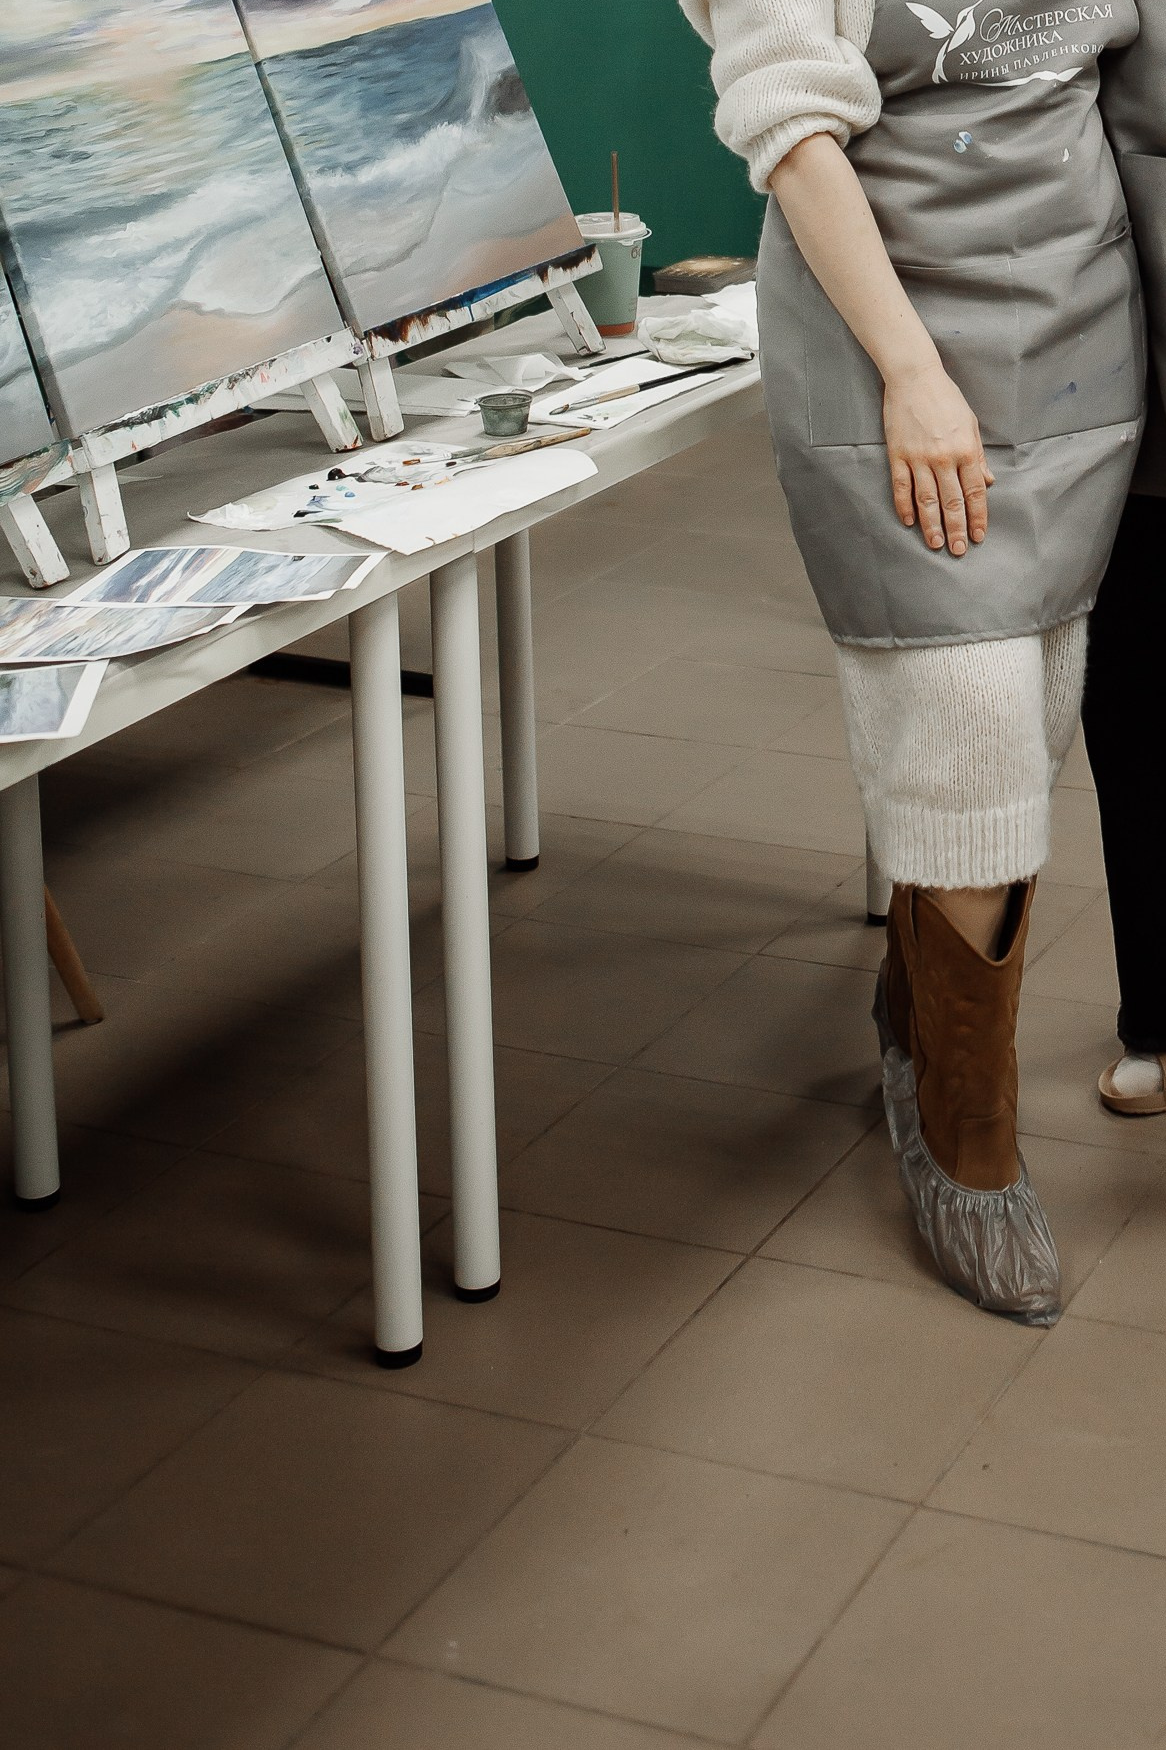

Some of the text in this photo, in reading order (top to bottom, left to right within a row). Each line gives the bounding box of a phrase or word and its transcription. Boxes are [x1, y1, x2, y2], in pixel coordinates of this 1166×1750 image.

[980, 3, 1113, 43] МАСТЕРСКАЯ
[959, 29, 1063, 66] ХУДОЖНИКА
[960, 44, 1104, 80] ИРИНЫ ПАВЛЕНКОВО
